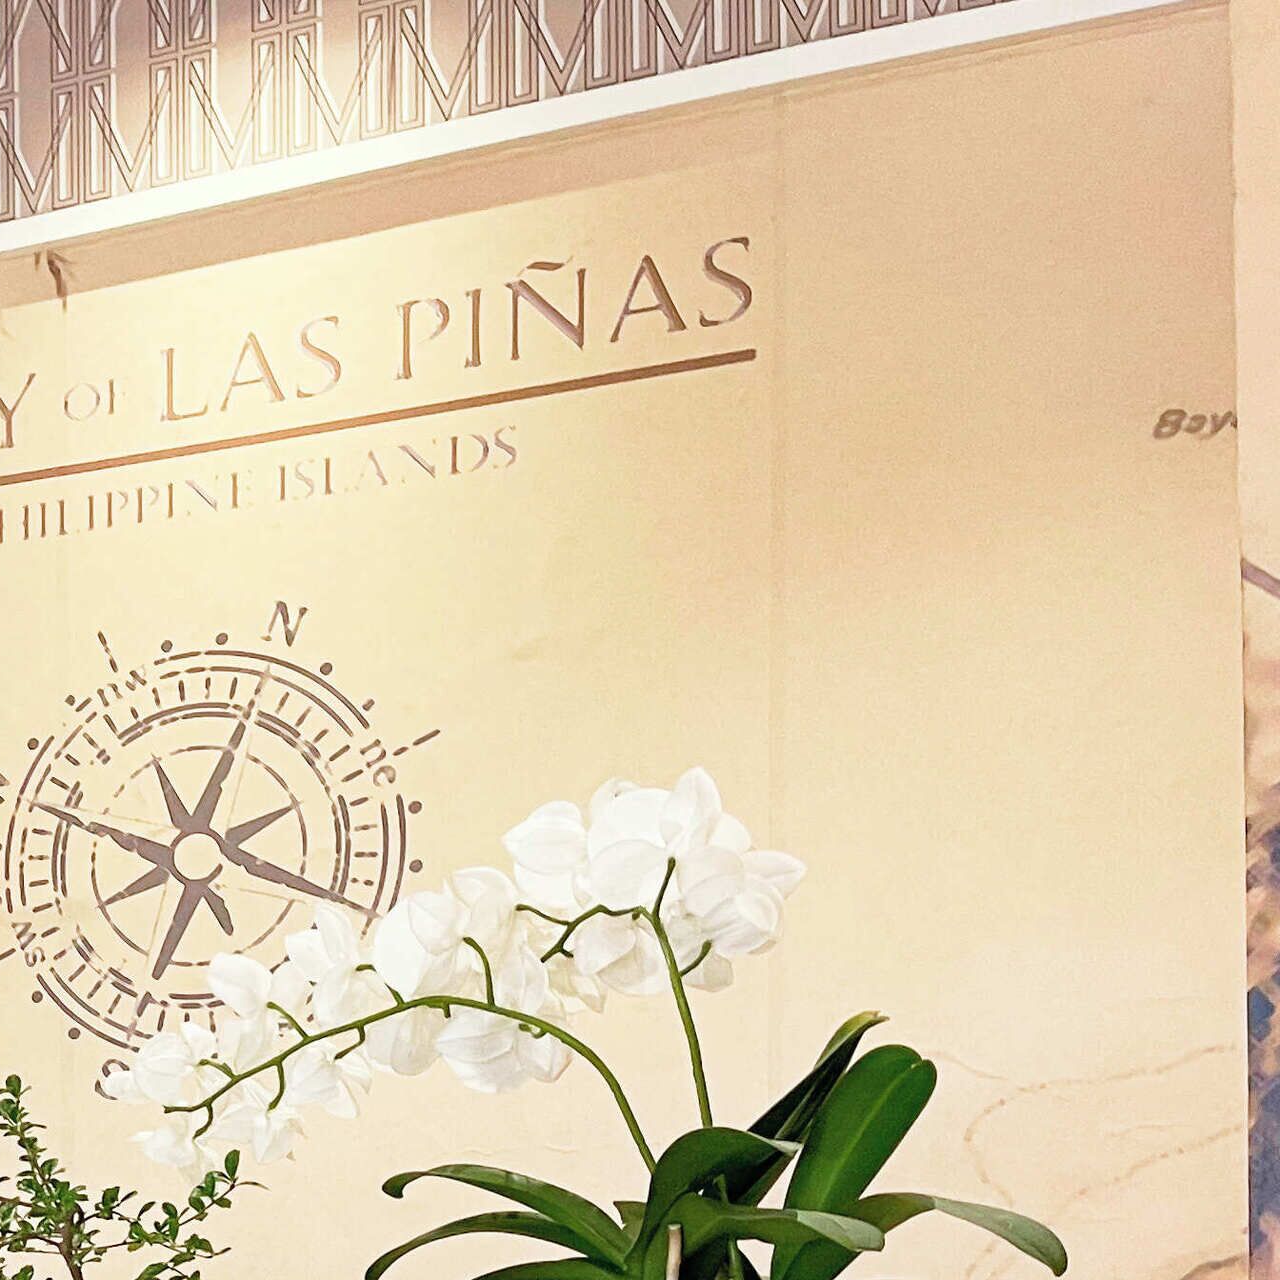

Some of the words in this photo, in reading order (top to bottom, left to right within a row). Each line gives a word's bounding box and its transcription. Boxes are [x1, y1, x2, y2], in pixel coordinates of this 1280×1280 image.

[159, 316, 342, 422] LAS
[395, 236, 753, 381] PIÑAS
[278, 424, 518, 502] ISLANDS
[260, 600, 309, 647] N
